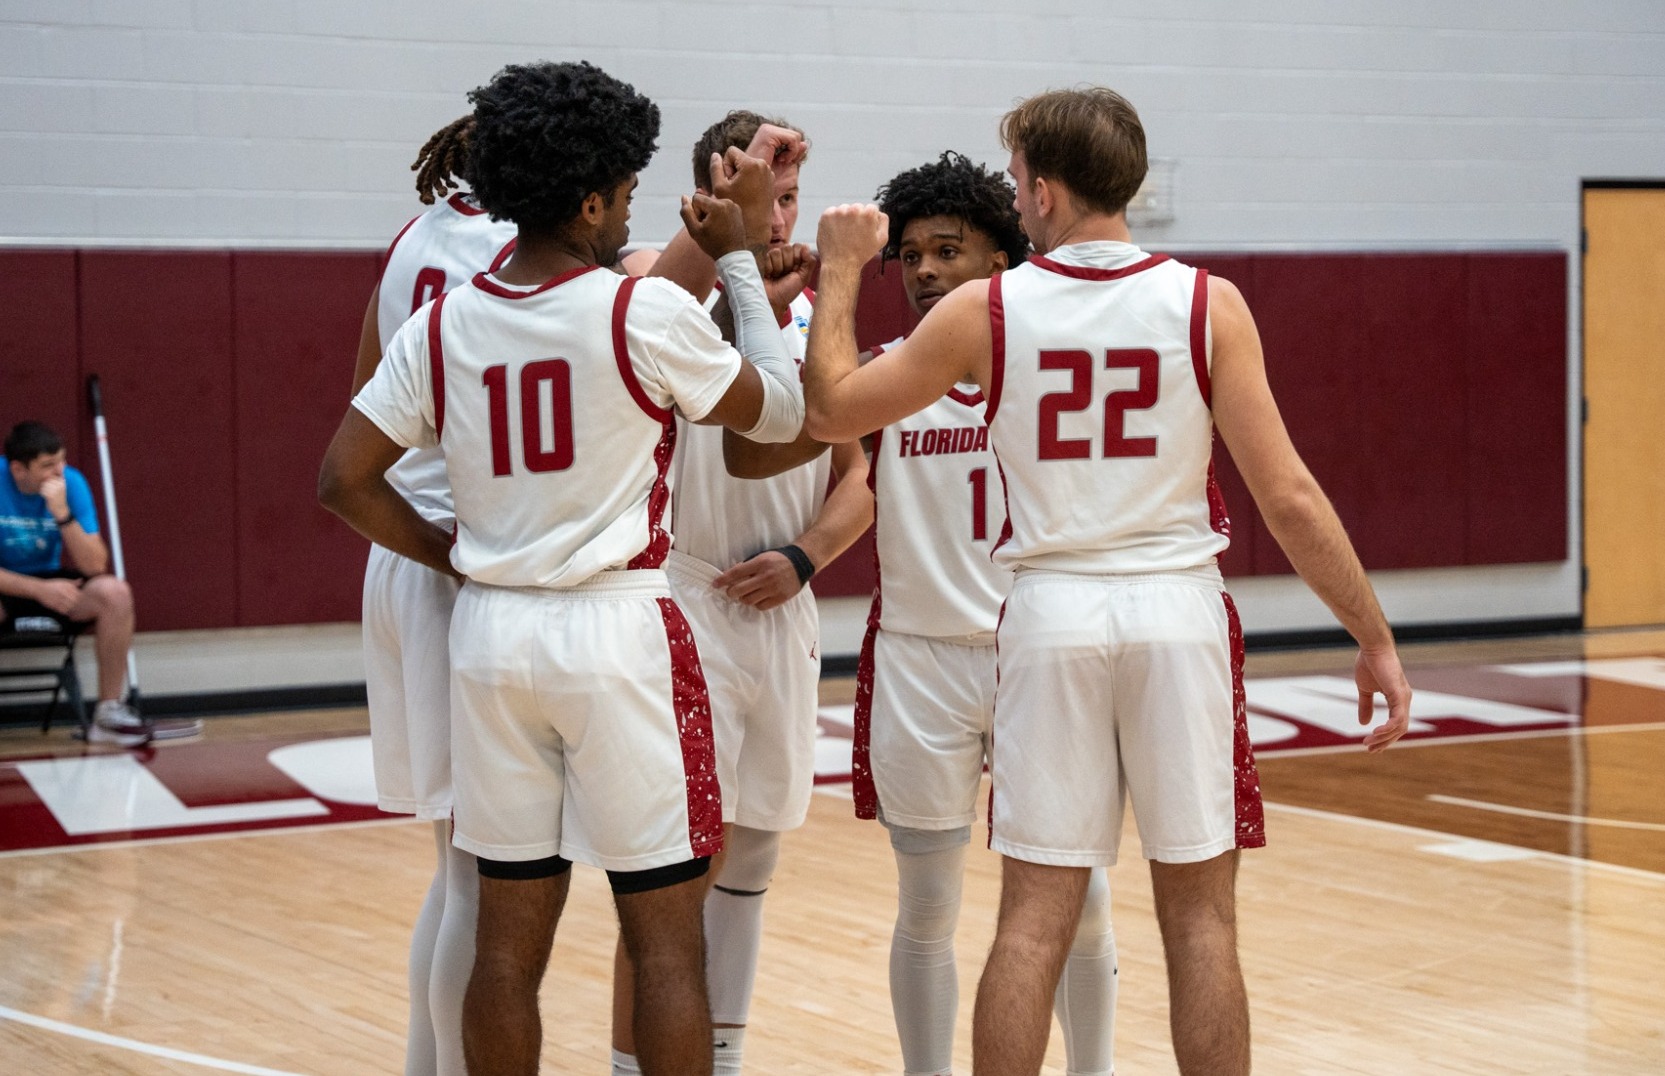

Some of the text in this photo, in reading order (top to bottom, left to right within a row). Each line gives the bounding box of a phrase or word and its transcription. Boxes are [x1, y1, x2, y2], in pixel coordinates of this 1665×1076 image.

[481, 356, 576, 478] 10
[899, 426, 989, 458] FLORIDA
[1037, 346, 1161, 463] 22
[967, 466, 988, 542] 1
